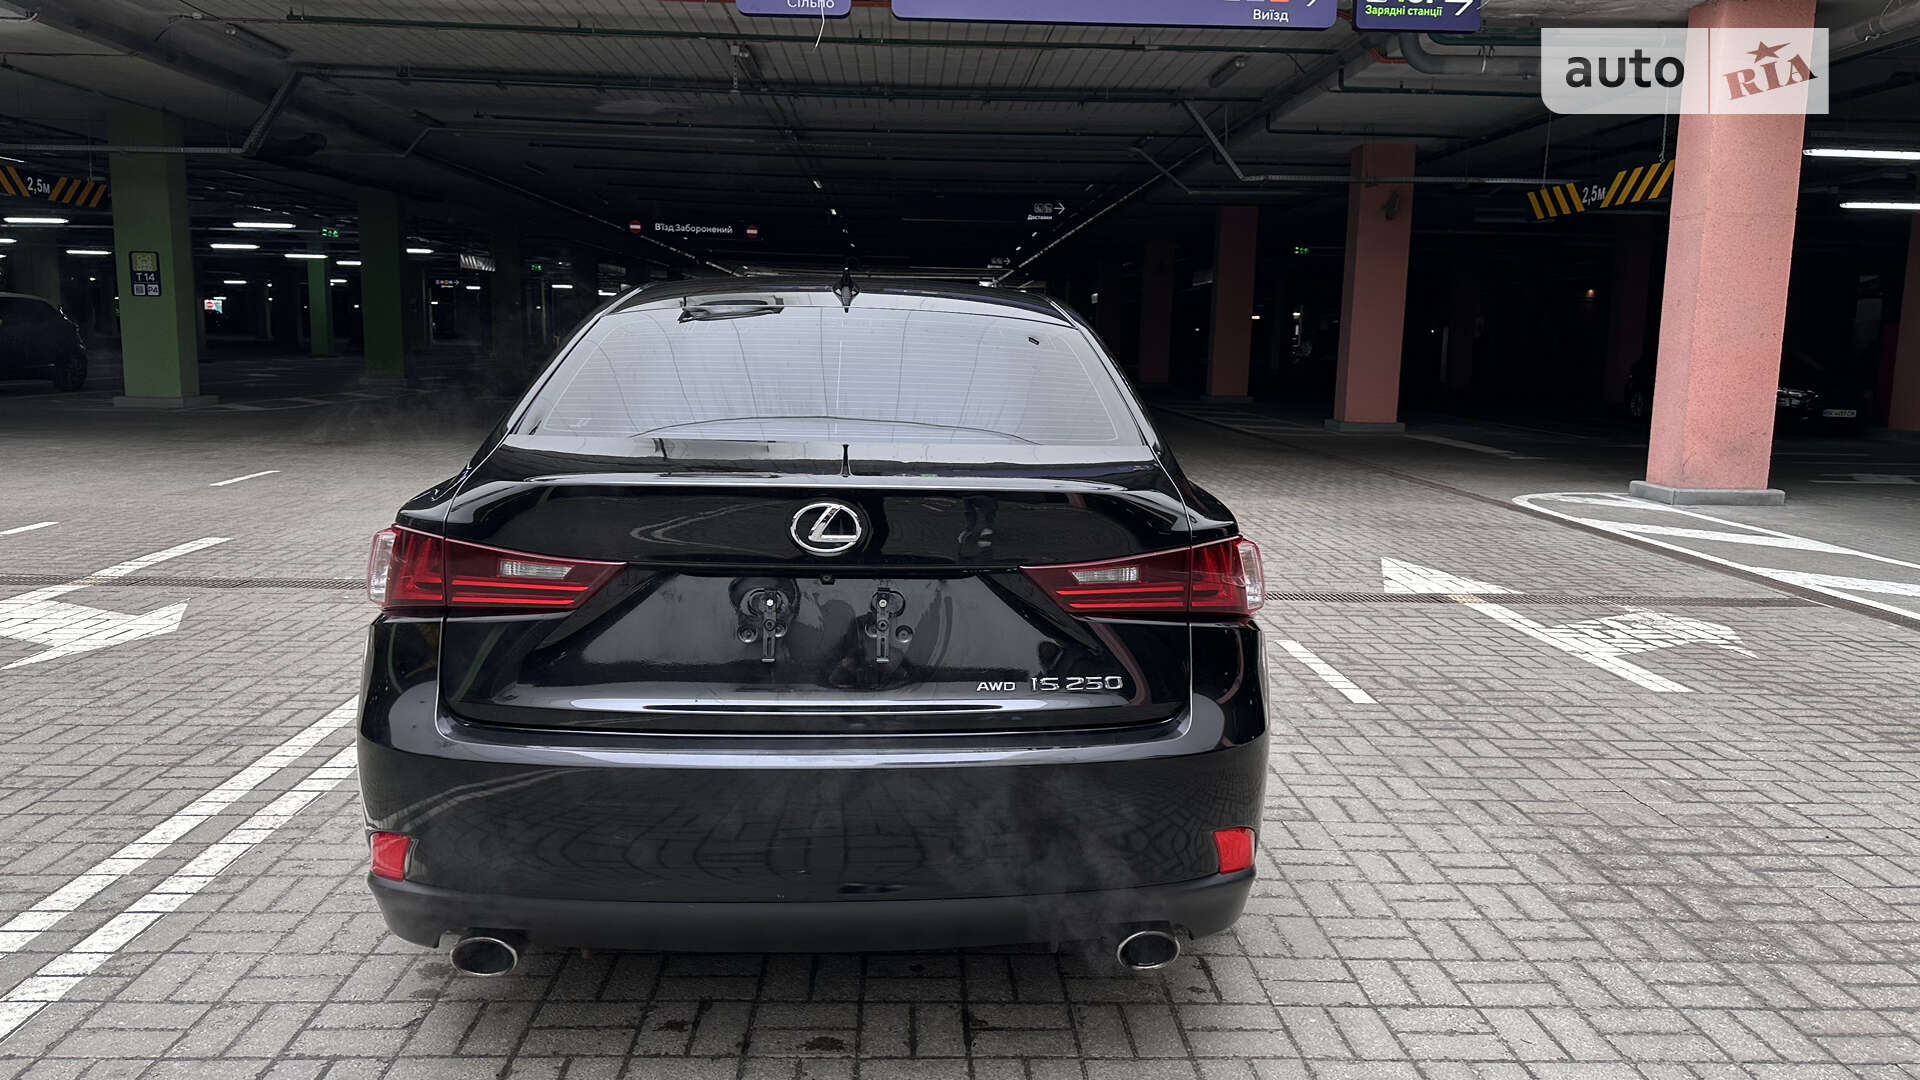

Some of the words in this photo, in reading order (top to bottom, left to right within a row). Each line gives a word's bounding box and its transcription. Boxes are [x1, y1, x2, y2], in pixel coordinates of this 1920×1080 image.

[1253, 8, 1289, 23] Виїзд
[1365, 4, 1406, 17] Зарядні
[1407, 6, 1443, 18] станції
[976, 681, 1016, 692] AWD
[1031, 677, 1060, 691] IS
[1065, 676, 1123, 691] 250
